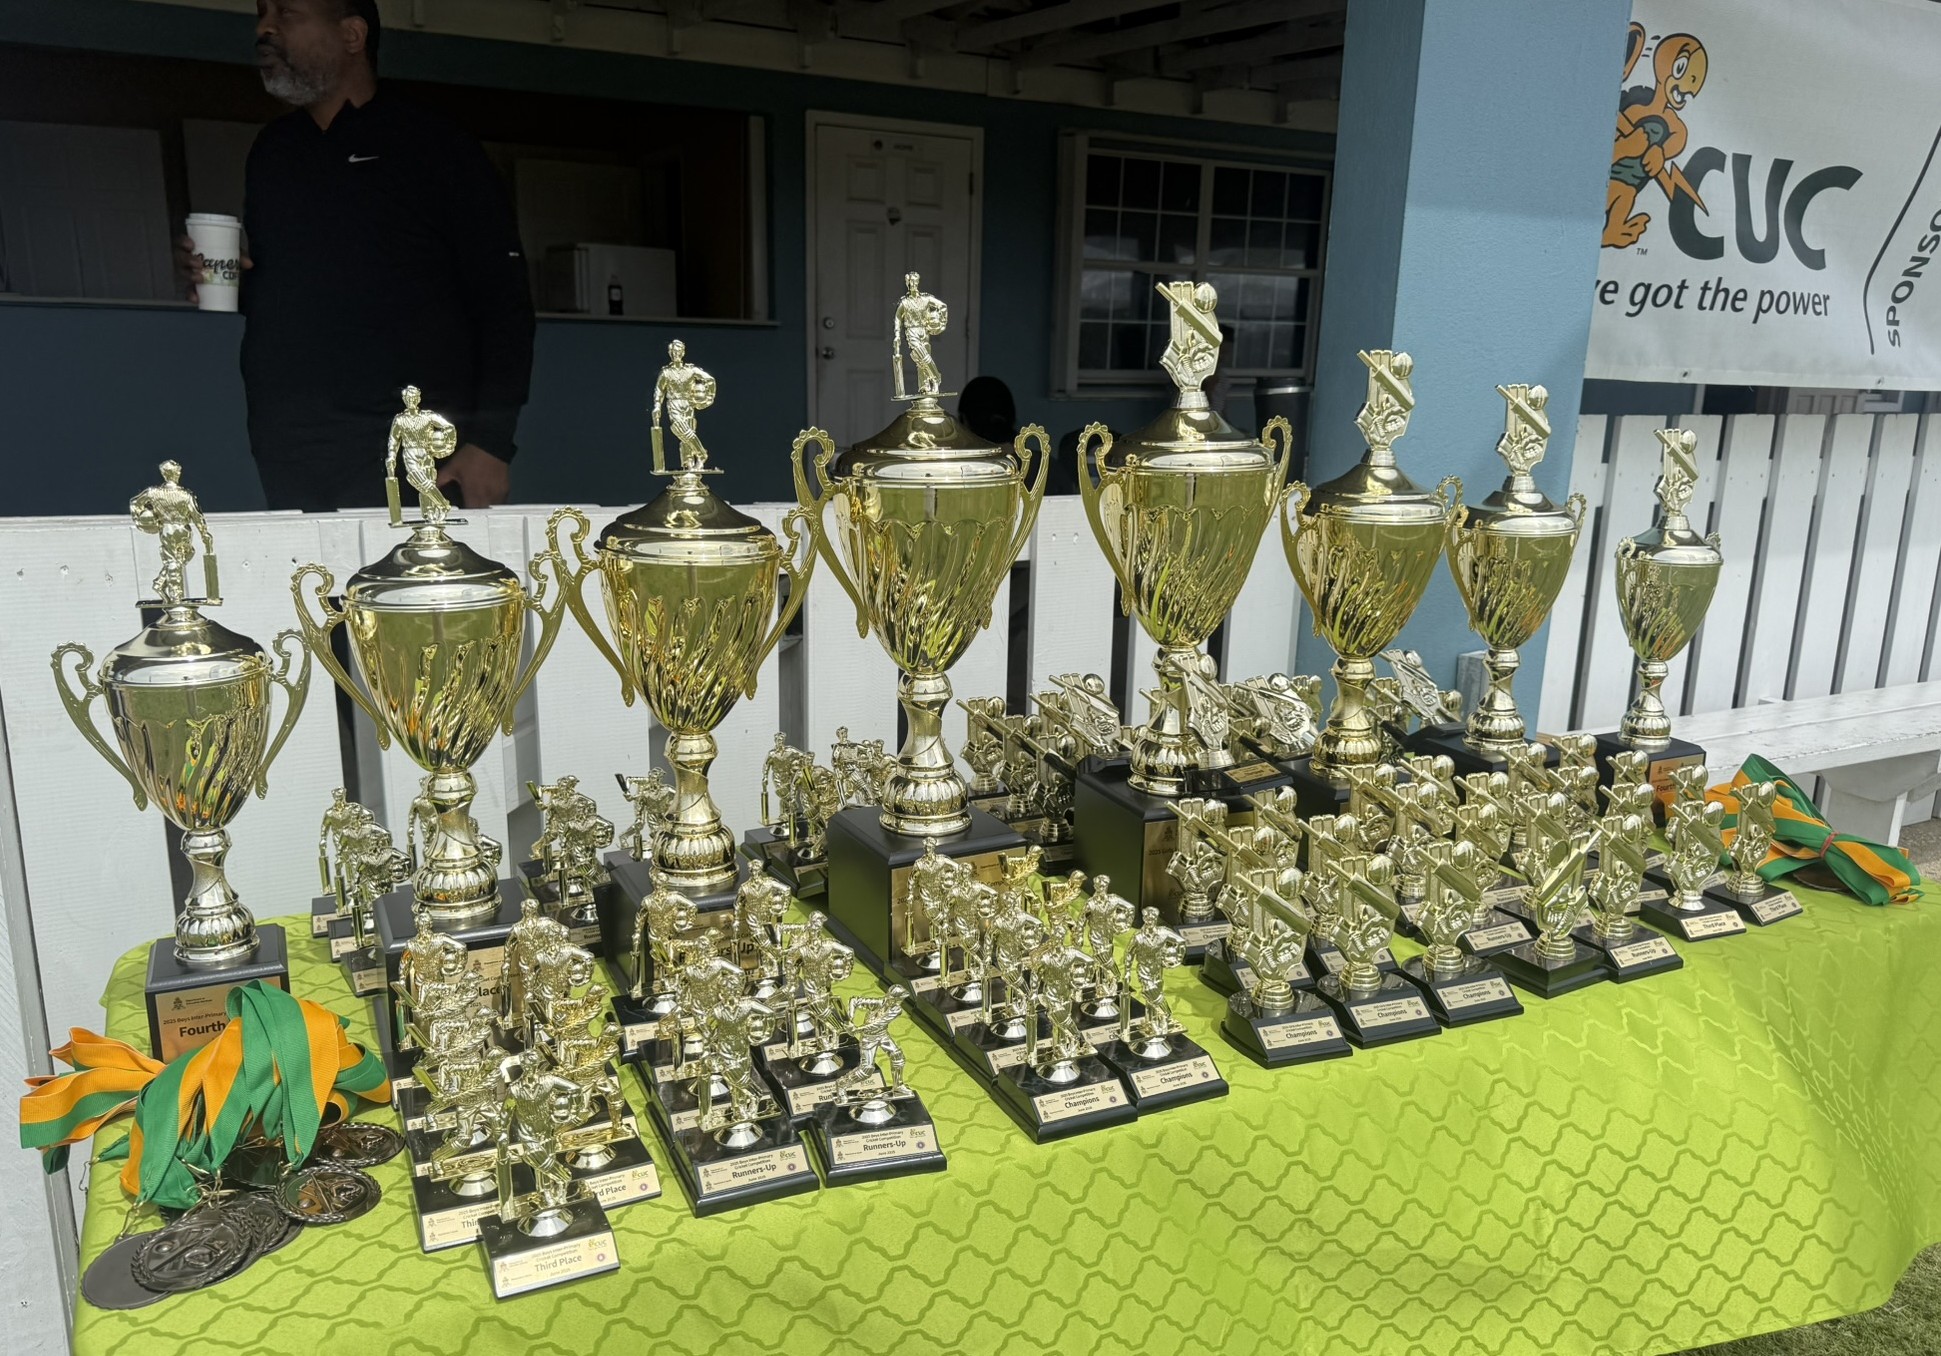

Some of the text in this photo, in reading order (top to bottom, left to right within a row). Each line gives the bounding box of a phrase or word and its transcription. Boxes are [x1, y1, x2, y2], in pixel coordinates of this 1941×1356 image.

[1668, 146, 1863, 271] CUC
[1636, 247, 1648, 256] TM
[1625, 279, 1689, 317] got
[1697, 276, 1748, 312] the
[1752, 288, 1830, 324] power
[179, 1020, 226, 1037] Fourth
[1064, 1095, 1100, 1109] Champions
[863, 1139, 906, 1151] Runners-Up
[731, 1163, 776, 1179] Runners-Up
[605, 1184, 626, 1195] Place
[534, 1259, 557, 1272] Third
[559, 1254, 582, 1266] Place
